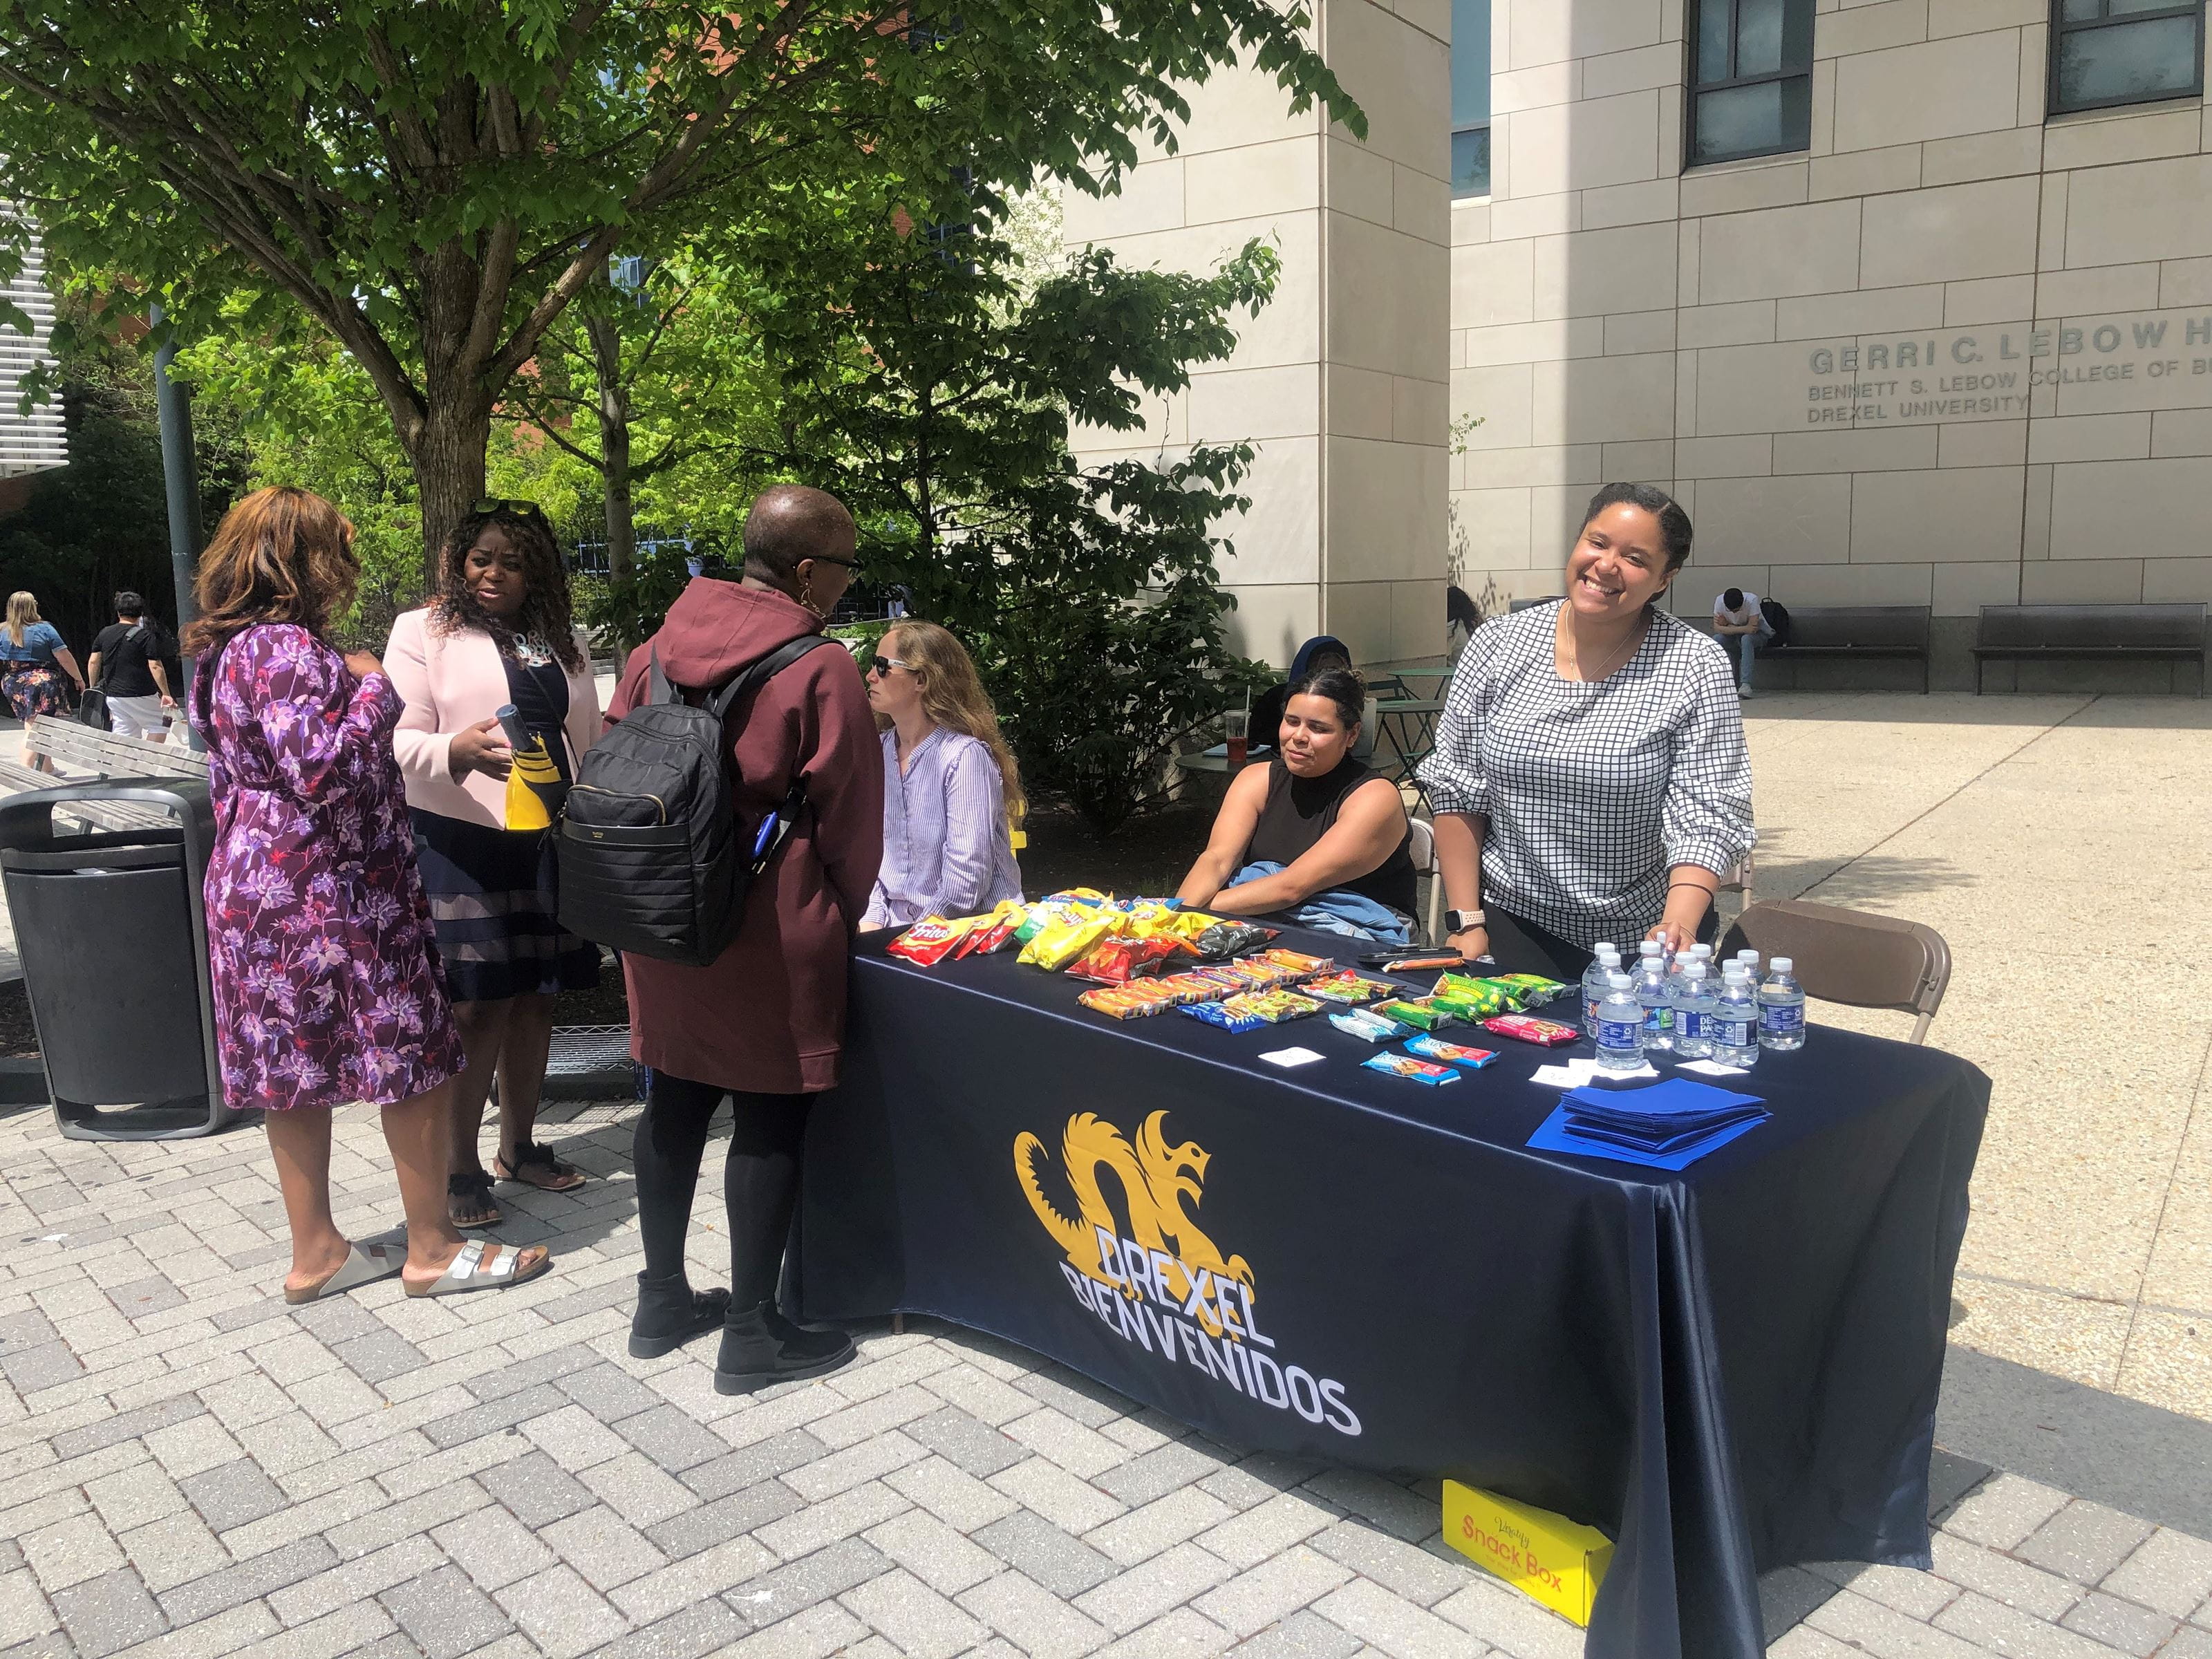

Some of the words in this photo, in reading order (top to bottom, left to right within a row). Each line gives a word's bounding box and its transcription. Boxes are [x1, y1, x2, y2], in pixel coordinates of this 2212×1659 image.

[1809, 340, 1935, 375] GERRI
[1951, 336, 1983, 364] C.
[2000, 319, 2168, 360] LEBOW
[1807, 404, 1888, 423] DREXEL
[1900, 393, 2029, 418] UNIVERSITY
[1808, 380, 1898, 402] BENNETT
[1910, 378, 1928, 395] S.
[1939, 371, 2017, 393] LEBOW
[2029, 362, 2135, 386] COLLEGE
[2147, 359, 2179, 378] OF
[908, 922, 951, 939] Fritos
[1094, 1224, 1275, 1348] DREXEL
[1059, 1260, 1362, 1436] BIENVENIDOS
[1461, 1514, 1521, 1568] Snack
[1526, 1551, 1562, 1593] Box
